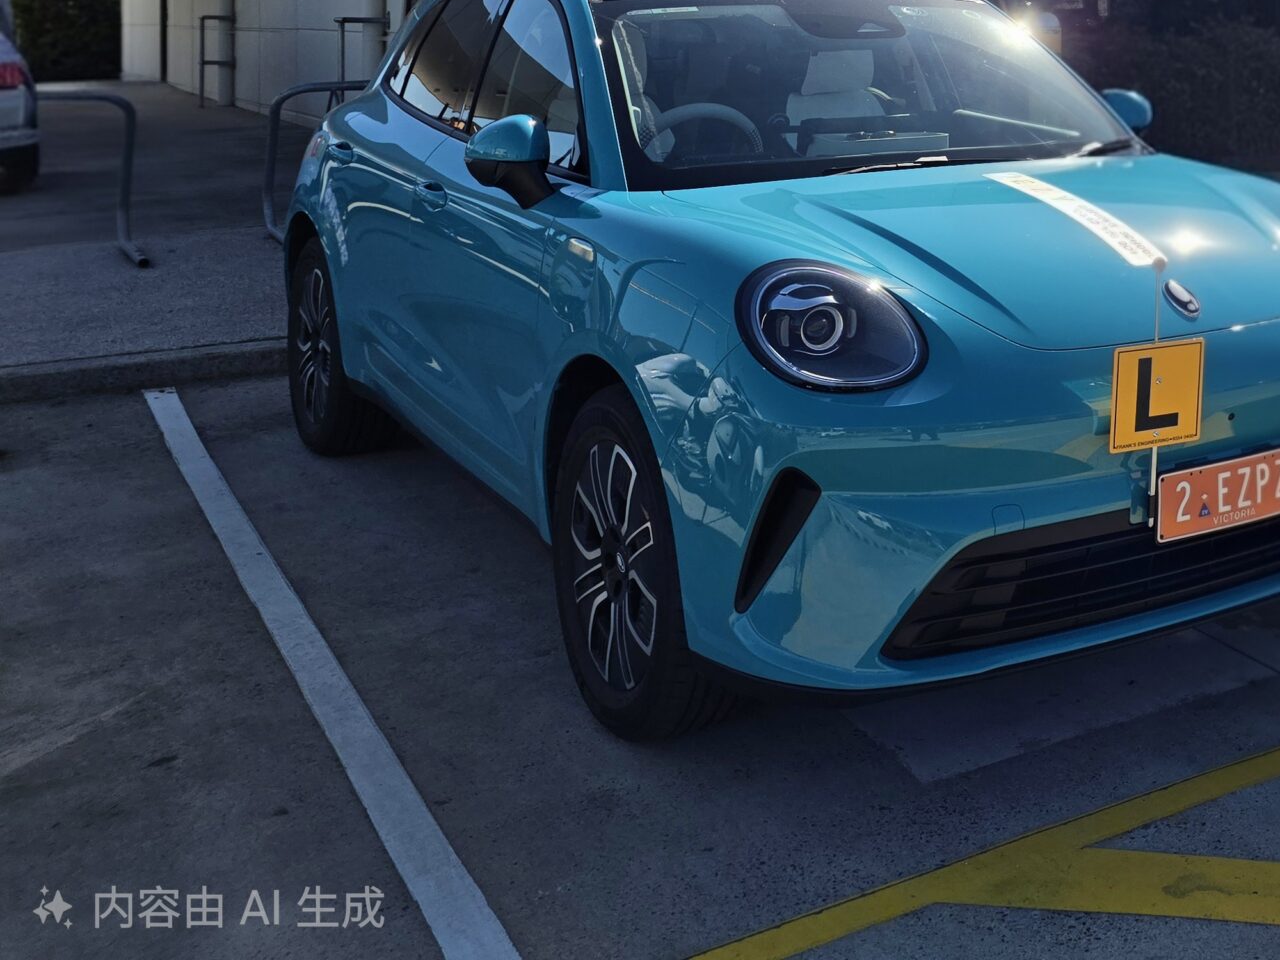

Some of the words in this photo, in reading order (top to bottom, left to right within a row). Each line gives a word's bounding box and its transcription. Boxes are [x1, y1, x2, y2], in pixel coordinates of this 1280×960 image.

[1135, 357, 1179, 432] L
[1176, 481, 1191, 522] 2
[1212, 507, 1256, 525] VICTORIA
